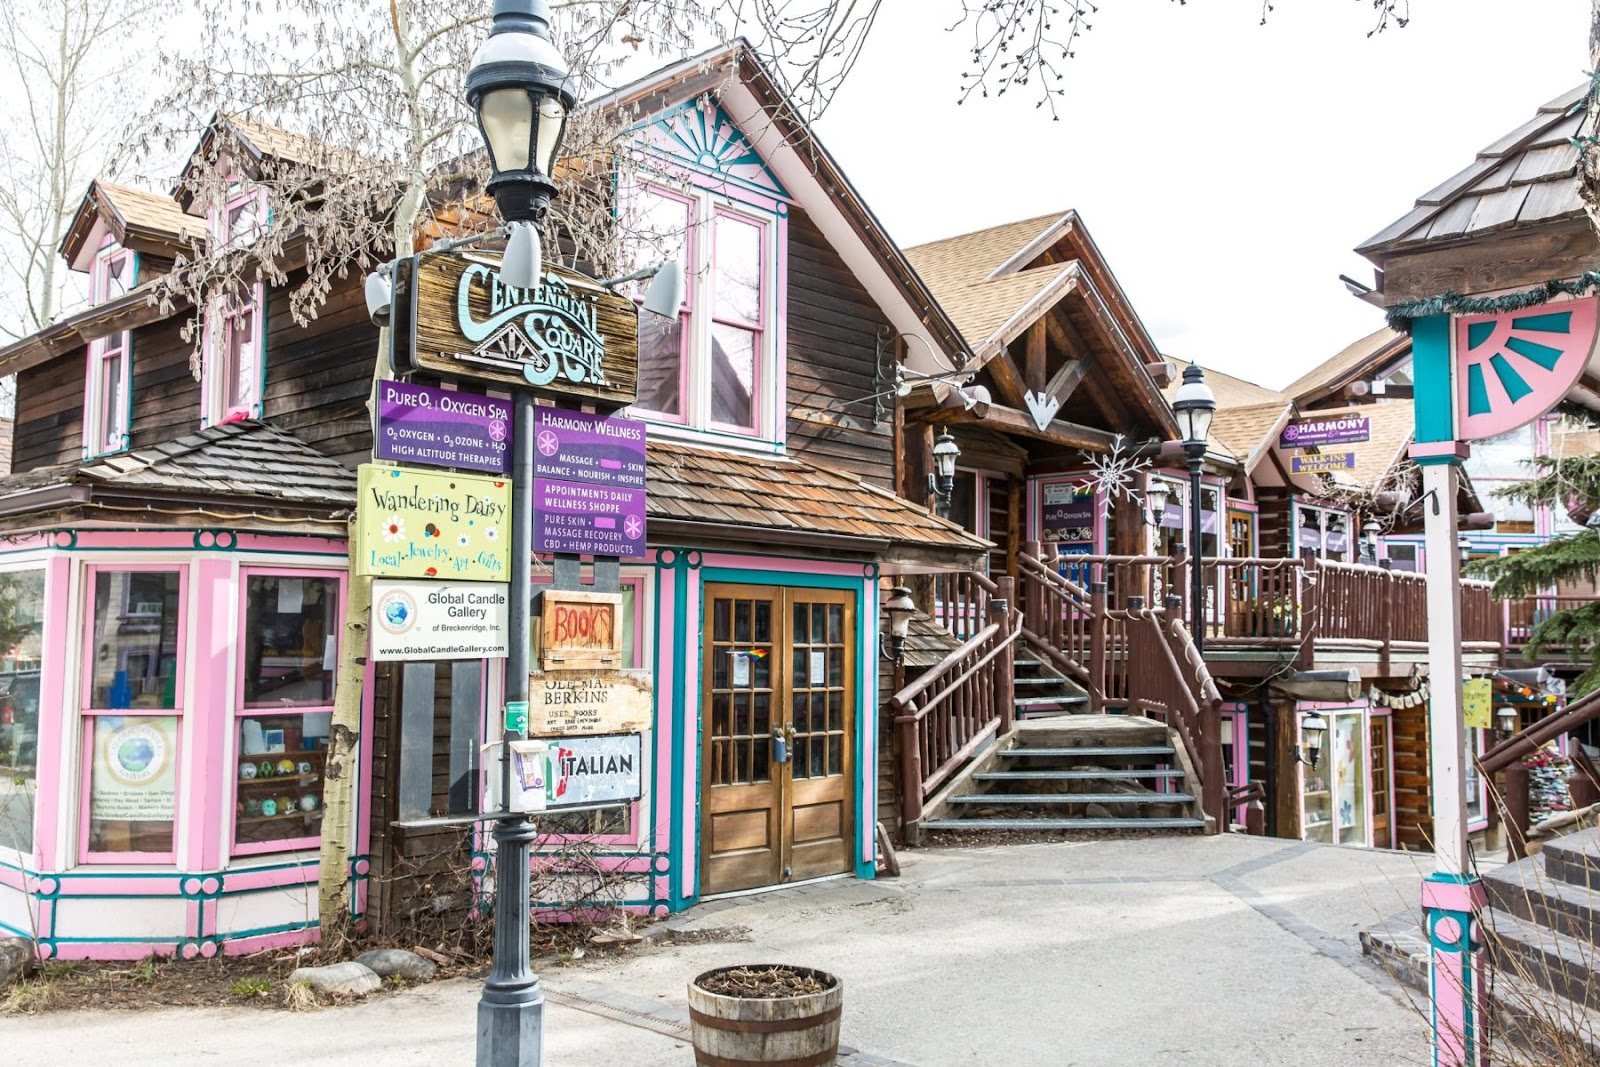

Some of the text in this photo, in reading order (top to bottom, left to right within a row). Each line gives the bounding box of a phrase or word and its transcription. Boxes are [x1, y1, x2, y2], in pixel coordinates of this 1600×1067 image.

[523, 313, 605, 386] SQUARE
[387, 388, 417, 407] PURE
[440, 397, 486, 417] OXYGEN
[488, 404, 508, 421] SPA
[542, 412, 641, 440] HARMONY WELLNESS
[1299, 419, 1365, 433] HARMONY
[399, 429, 434, 441] OXYGEN
[455, 437, 483, 448] OZONE
[391, 445, 501, 466] HIGH ALTITUDE THERAPIES
[559, 454, 644, 472] MASSAGE SKIN
[537, 465, 644, 485] BALANCE NOURISH INSPIRE
[1299, 462, 1347, 473] WELCOME
[545, 484, 633, 502] APPOINTMENTS DAILY
[370, 485, 507, 524] Wandering Daisy
[544, 497, 620, 513] WELLNESS SHOPPE
[544, 514, 586, 527] PURE SKIN
[544, 527, 623, 541] MASSAGE RECOVERY
[544, 539, 633, 554] CBD HEMP PRODUCTS
[371, 542, 502, 572] Local Jewelry Art Gifts
[428, 593, 505, 605] Global Candle
[448, 606, 487, 620] Gallery
[432, 624, 440, 632] of
[441, 624, 488, 633] Breckenridge,
[554, 606, 612, 643] BOOKS
[379, 645, 505, 654] www.GlobalCandleGallery.com
[545, 691, 608, 705] BERKINS
[573, 709, 598, 718] BOOKS
[561, 754, 633, 776] ITALIAN
